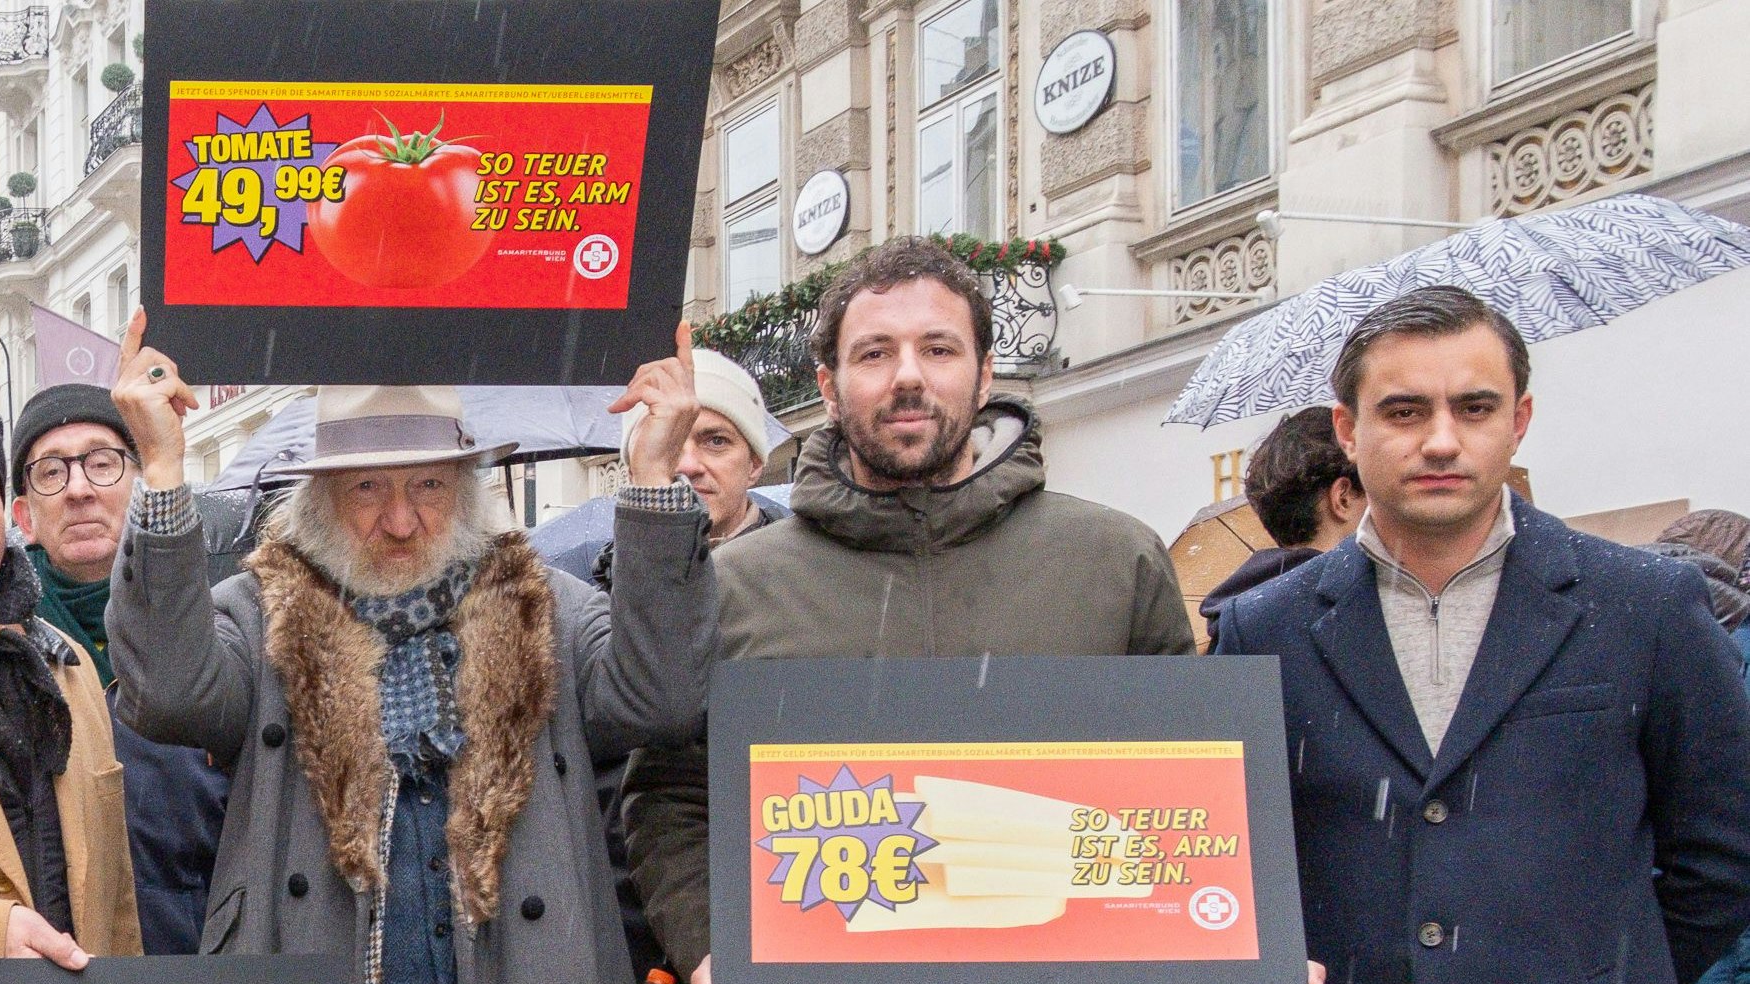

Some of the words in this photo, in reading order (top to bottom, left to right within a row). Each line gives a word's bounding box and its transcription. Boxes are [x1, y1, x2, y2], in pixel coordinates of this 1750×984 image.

[228, 88, 267, 96] SPENDEN
[270, 88, 287, 96] FÜR
[306, 89, 381, 97] SAMARITERBUND
[1043, 55, 1105, 106] KNIZE
[193, 129, 312, 164] TOMATE
[475, 152, 515, 175] SO
[522, 153, 608, 176] TEUER
[473, 180, 519, 203] IST
[522, 181, 564, 206] ES,
[567, 181, 631, 204] ARM
[471, 208, 509, 231] ZU
[513, 208, 583, 231] SEIN.
[797, 192, 842, 229] KNIZE
[761, 787, 902, 833] GOUDA
[1068, 808, 1109, 831] SO
[1117, 807, 1208, 831] TEUER
[1070, 835, 1118, 857] IST
[1123, 835, 1166, 860] ES,
[1173, 834, 1239, 856] ARM
[771, 835, 919, 905] 78€
[1071, 862, 1111, 885] ZU
[1116, 861, 1192, 885] SEIN.
